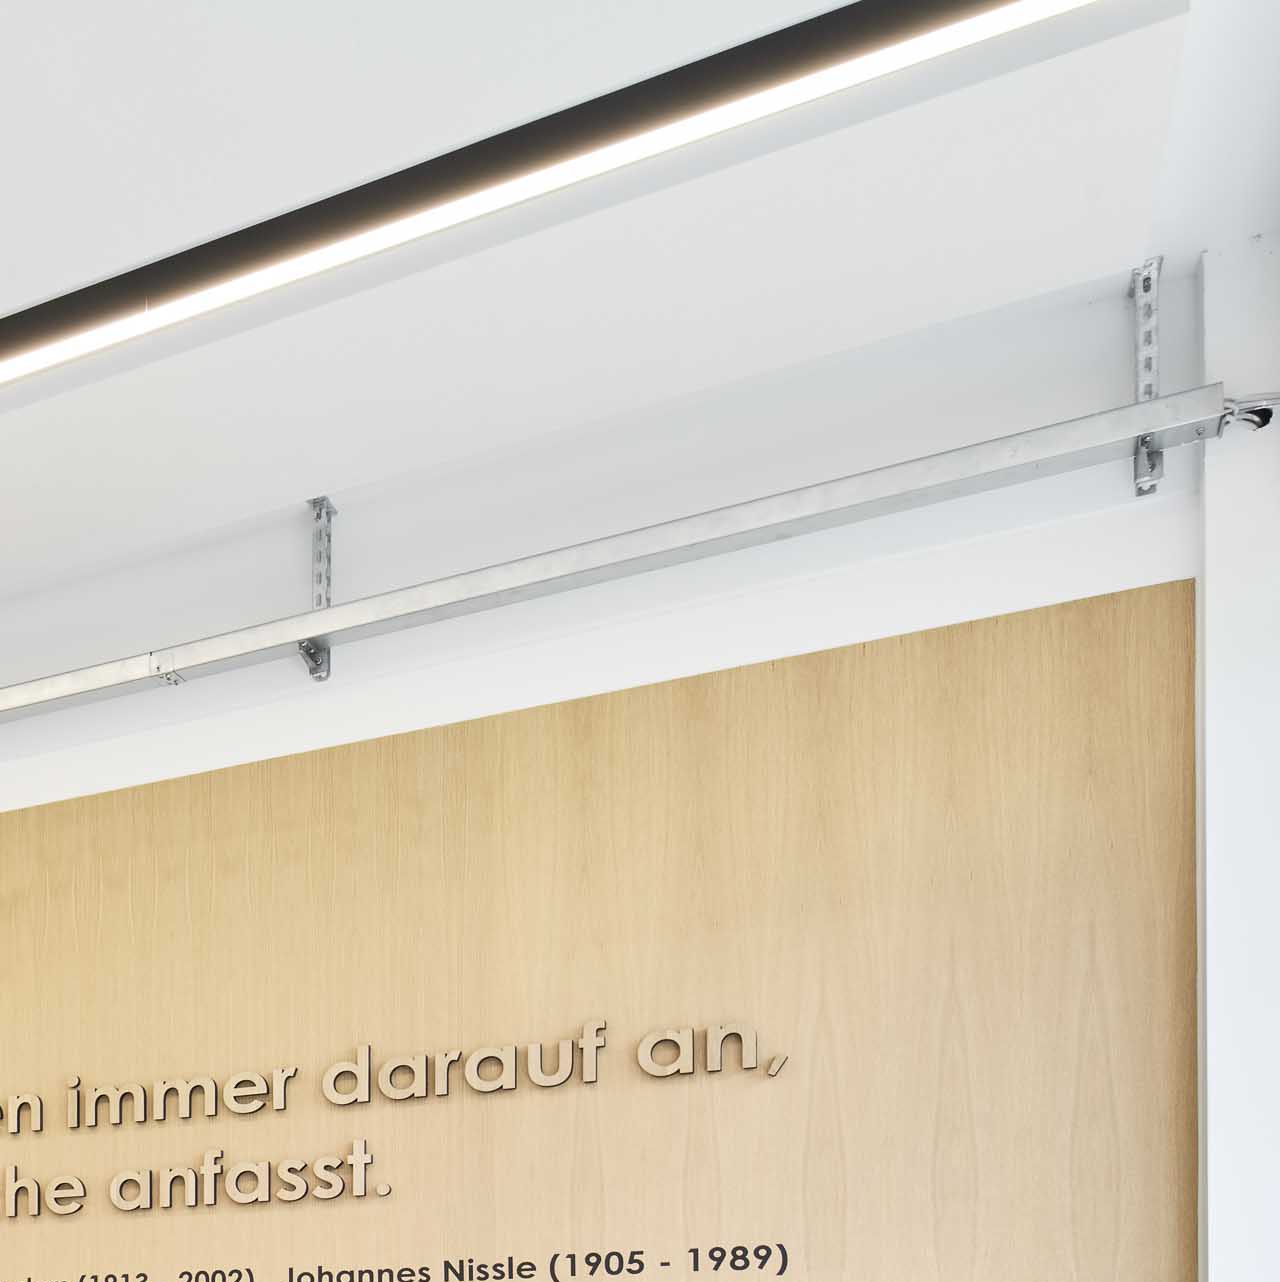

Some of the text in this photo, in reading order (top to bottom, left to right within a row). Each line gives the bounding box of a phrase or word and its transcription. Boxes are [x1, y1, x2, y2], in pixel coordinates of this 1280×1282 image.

[66, 1064, 298, 1130] immer
[321, 1020, 607, 1106] darauf
[637, 1021, 789, 1078] an,
[109, 1138, 392, 1210] anfasst.
[443, 1256, 537, 1282] Nissle
[687, 1243, 789, 1276] 1989)
